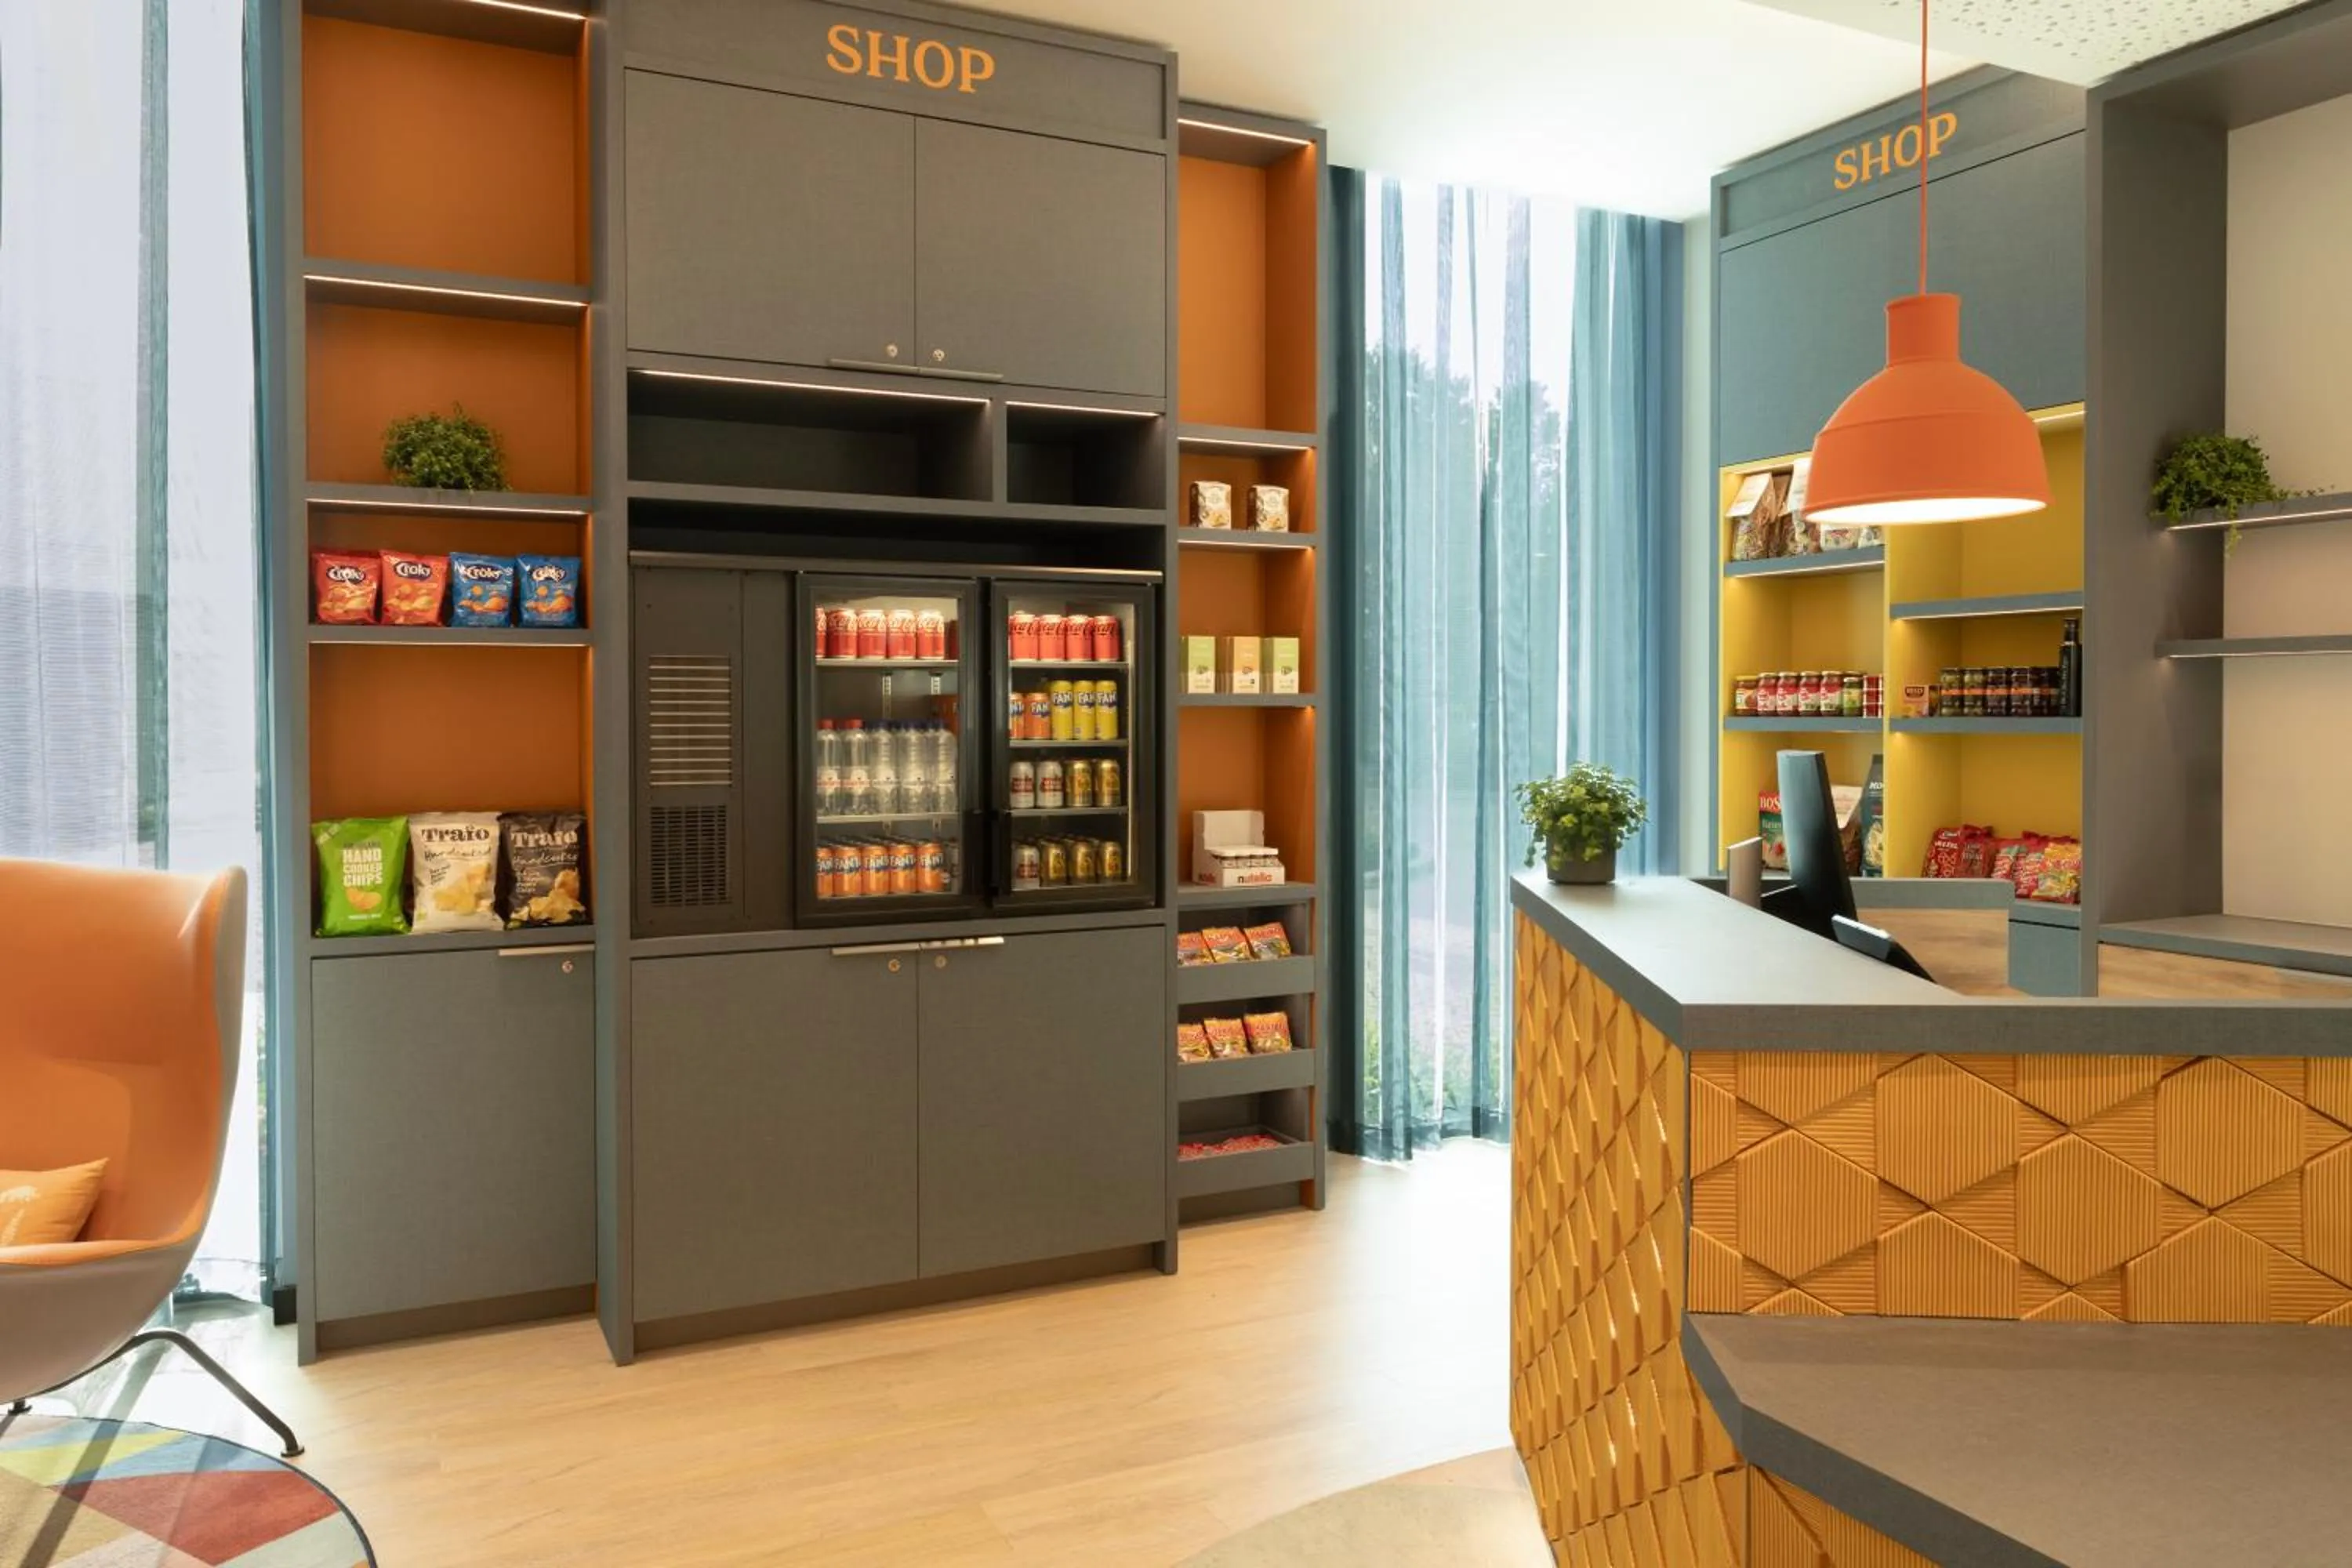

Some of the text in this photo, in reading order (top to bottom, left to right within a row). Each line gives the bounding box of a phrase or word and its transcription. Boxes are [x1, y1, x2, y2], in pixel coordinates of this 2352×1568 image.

[827, 24, 995, 93] SHOP
[1834, 112, 1958, 190] SHOP
[343, 848, 383, 863] HAND
[343, 872, 383, 887] CHIPS
